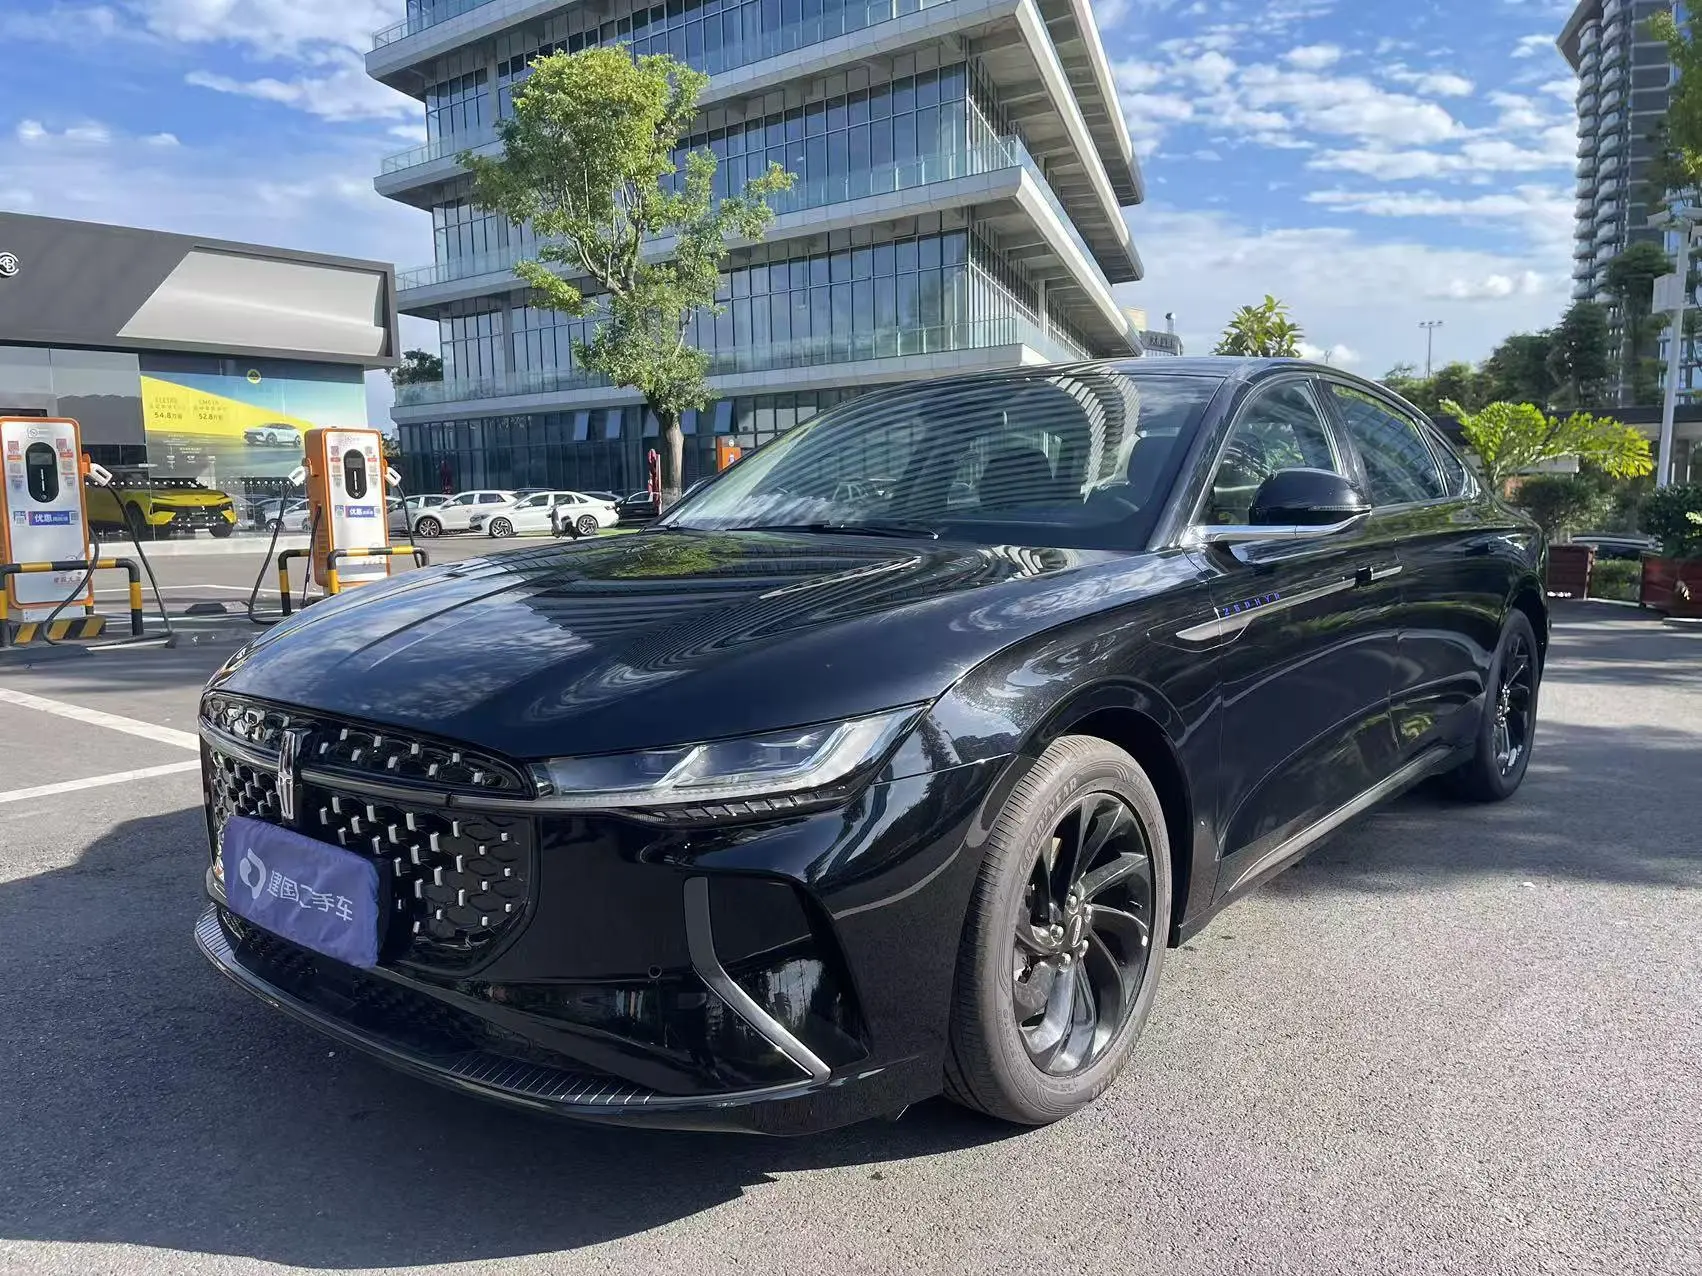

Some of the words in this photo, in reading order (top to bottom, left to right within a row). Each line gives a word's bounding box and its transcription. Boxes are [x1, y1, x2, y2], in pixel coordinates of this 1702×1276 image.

[1223, 592, 1280, 615] ZEPHYR
[267, 870, 353, 921] 建国二手车
